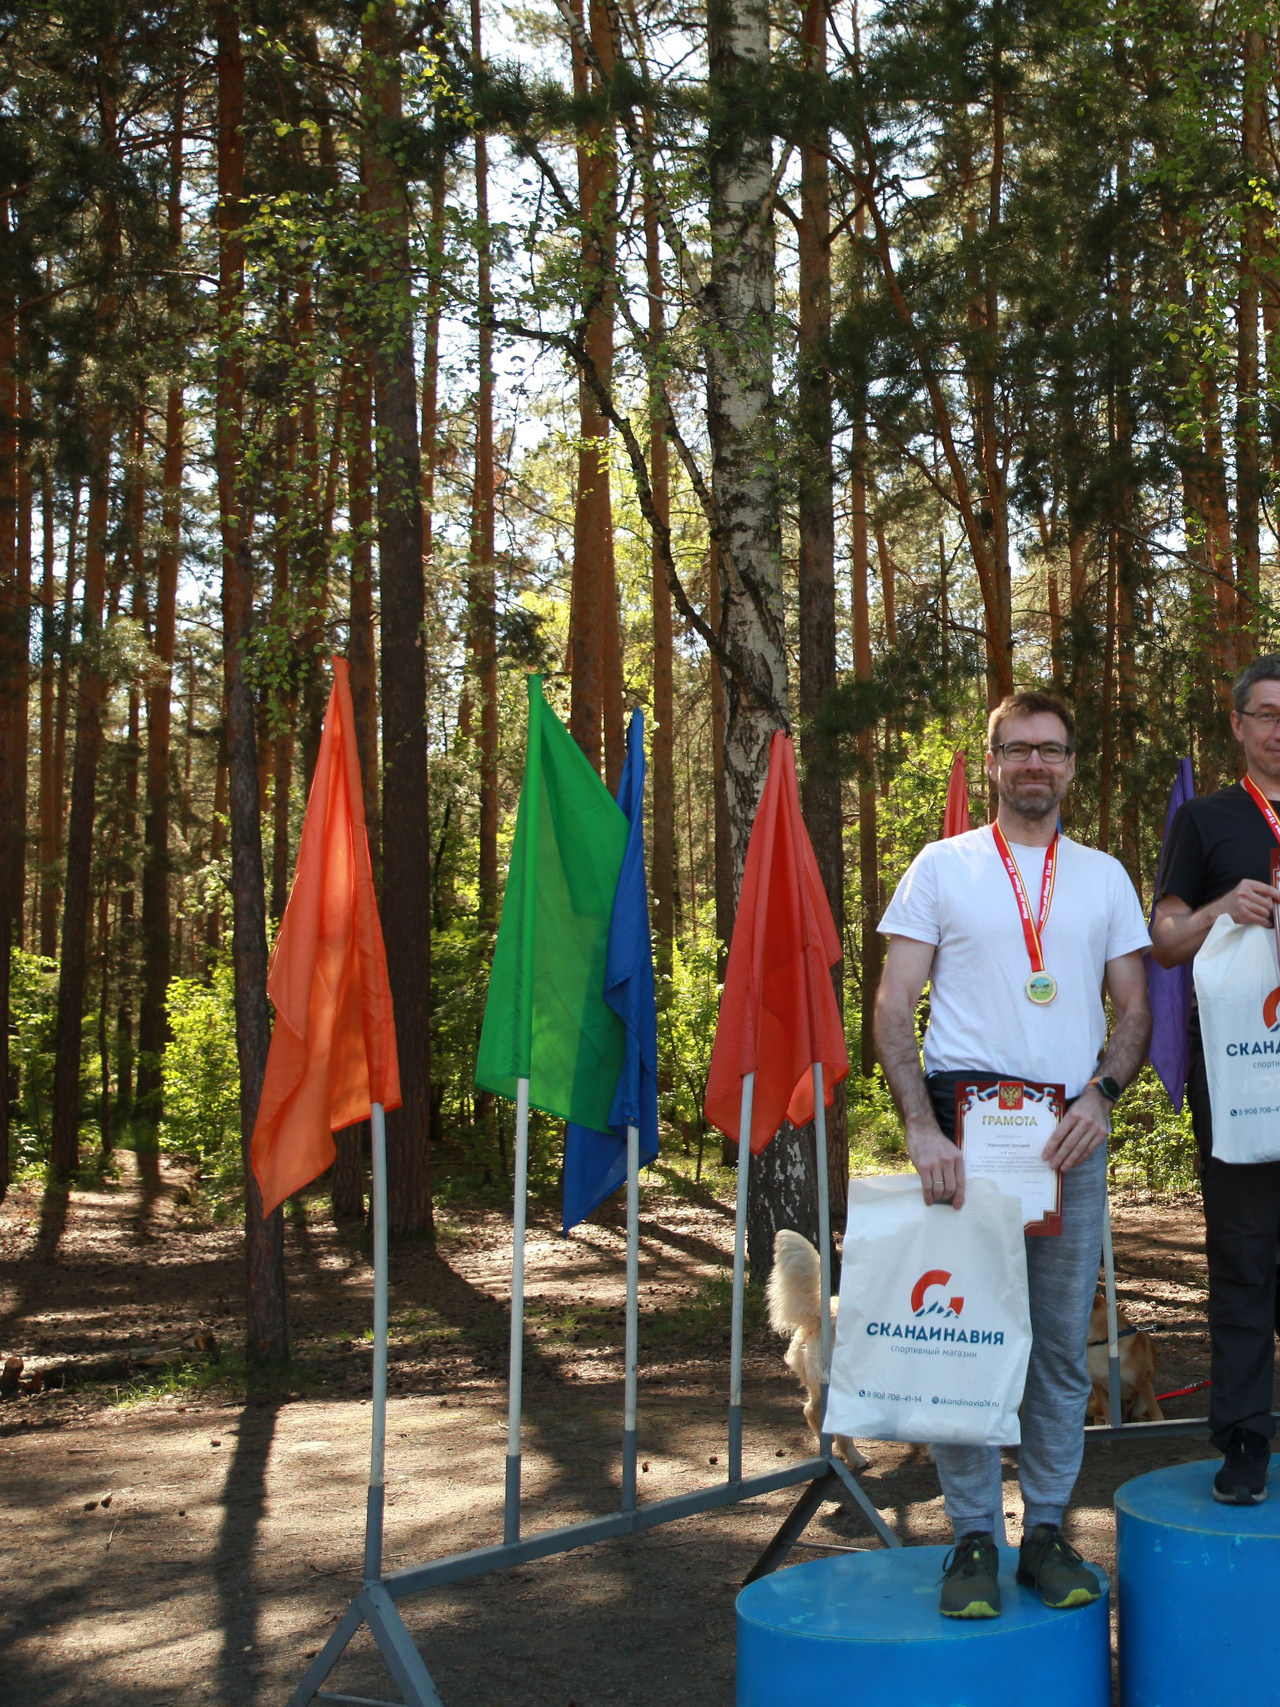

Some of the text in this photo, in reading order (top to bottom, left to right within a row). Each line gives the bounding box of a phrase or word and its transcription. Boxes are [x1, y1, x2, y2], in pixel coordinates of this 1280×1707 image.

[1244, 1107, 1257, 1115] 908
[982, 1115, 1038, 1126] ГРАМОТА
[867, 1322, 1004, 1345] СКАНДИНАВИЯ
[891, 1345, 977, 1358] спортивный магазин
[873, 1391, 886, 1399] 908
[887, 1393, 922, 1402] 708-41-14
[940, 1397, 1000, 1407] skandinavia74.ru
